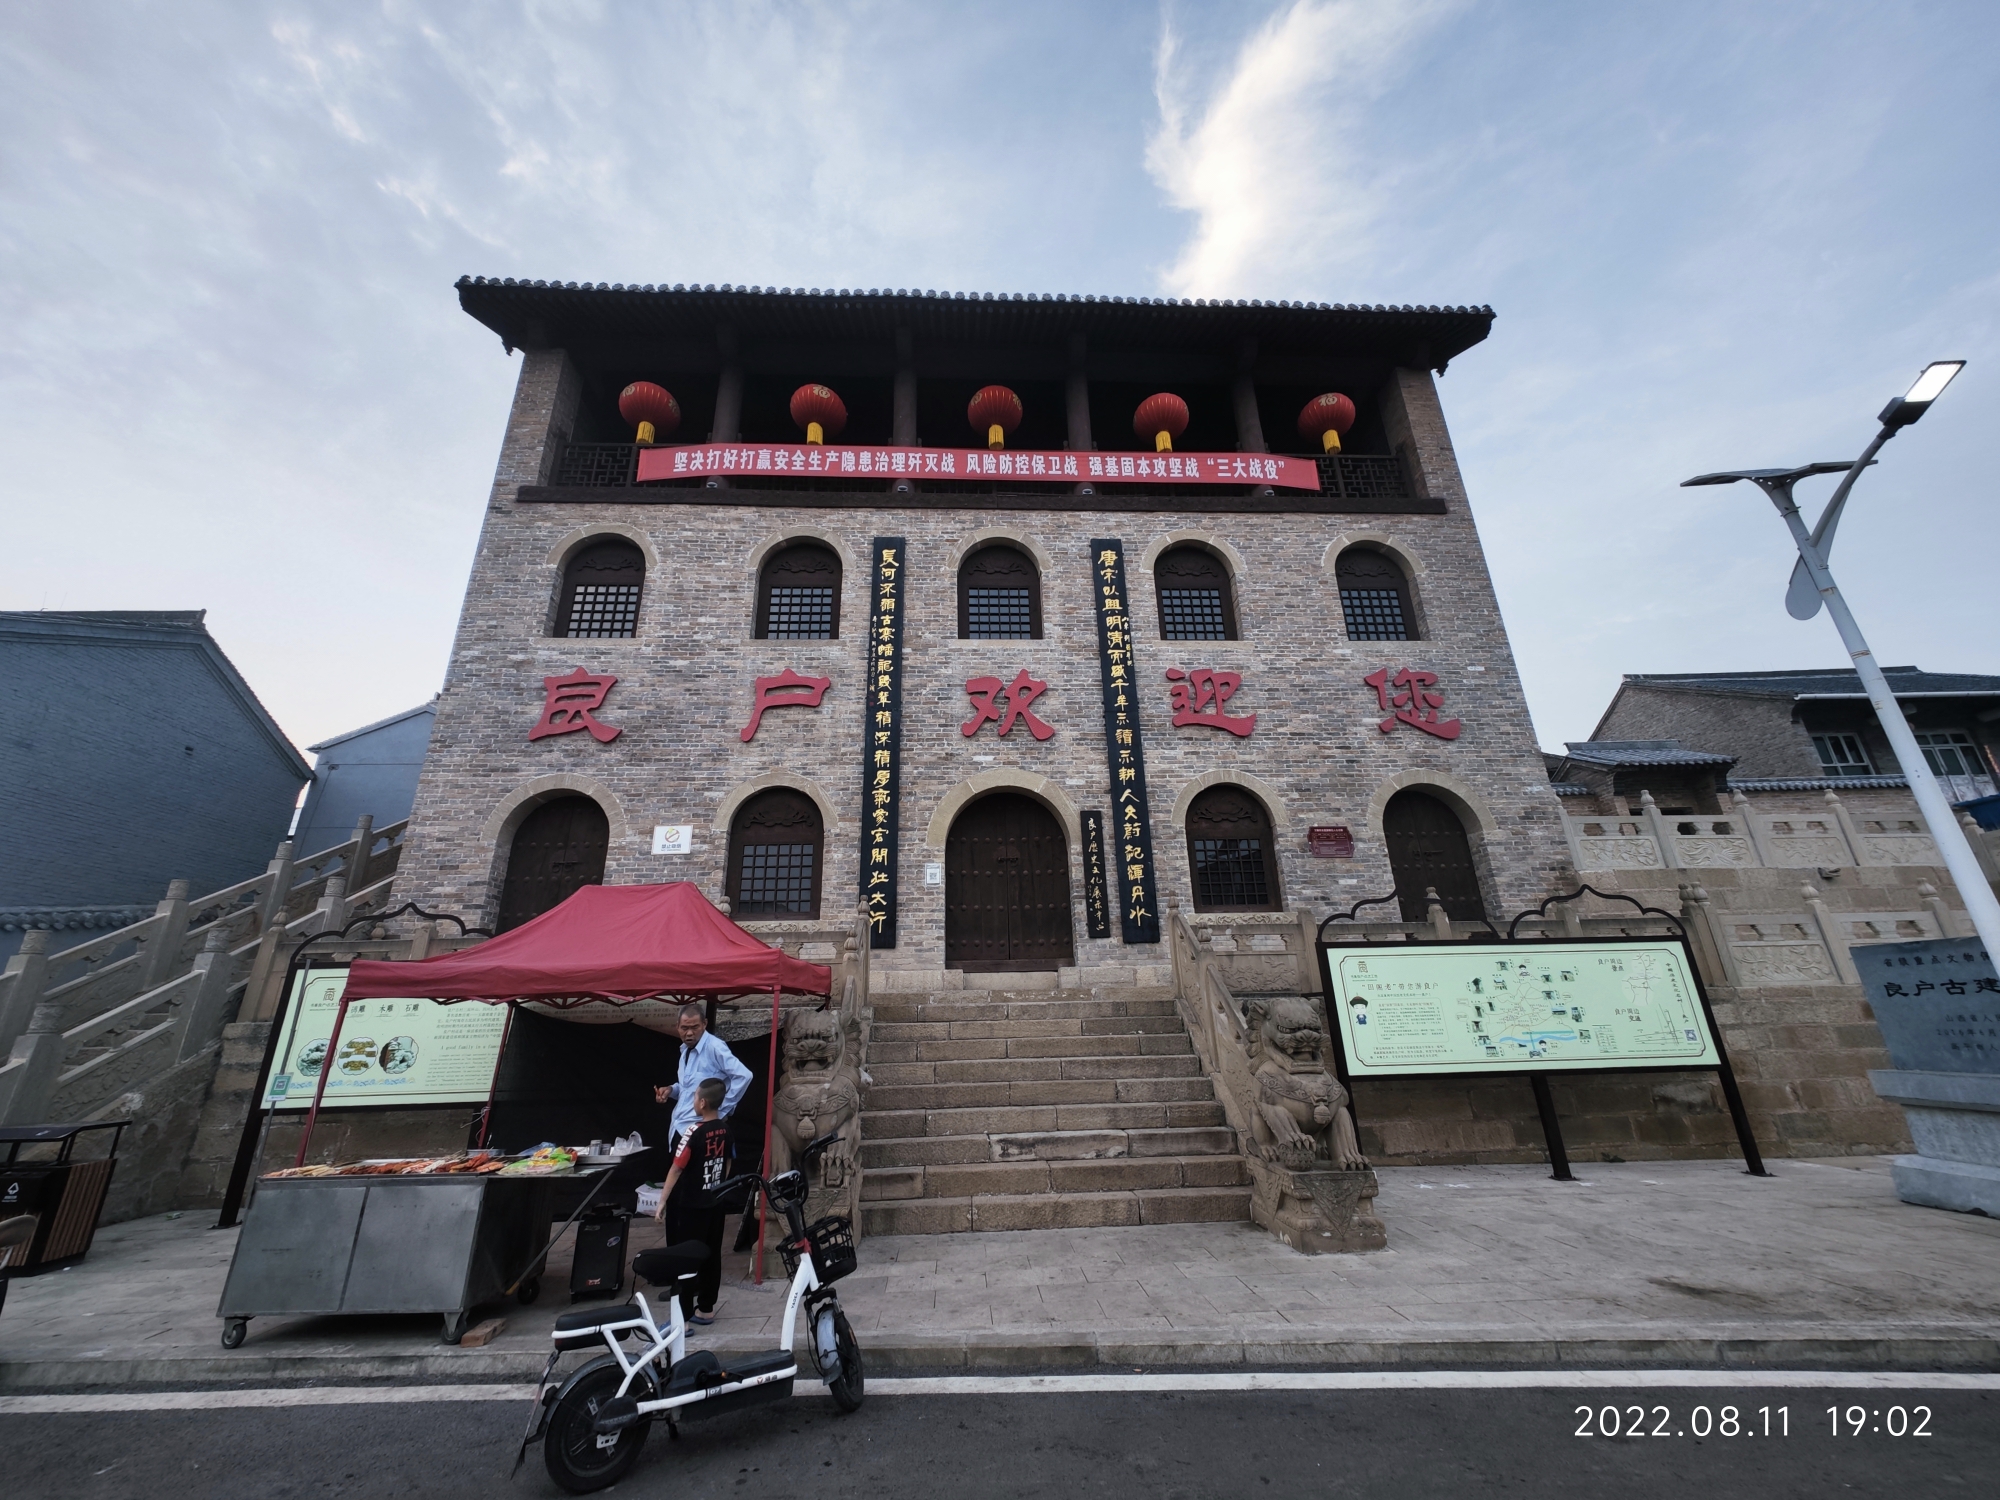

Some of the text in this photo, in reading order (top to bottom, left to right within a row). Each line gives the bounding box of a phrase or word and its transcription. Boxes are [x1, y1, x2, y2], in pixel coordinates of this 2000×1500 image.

[813, 385, 831, 399] 福
[1318, 393, 1338, 407] 福
[673, 448, 956, 473] 坚决打好打赢安全生产隐患治理歼灭战
[966, 453, 1079, 476] 风险防控保卫战
[1089, 455, 1200, 479] 强基固本攻坚战
[1883, 977, 2000, 998] 良户古建
[379, 1003, 394, 1013] 木雕
[405, 1003, 420, 1012] 石雕
